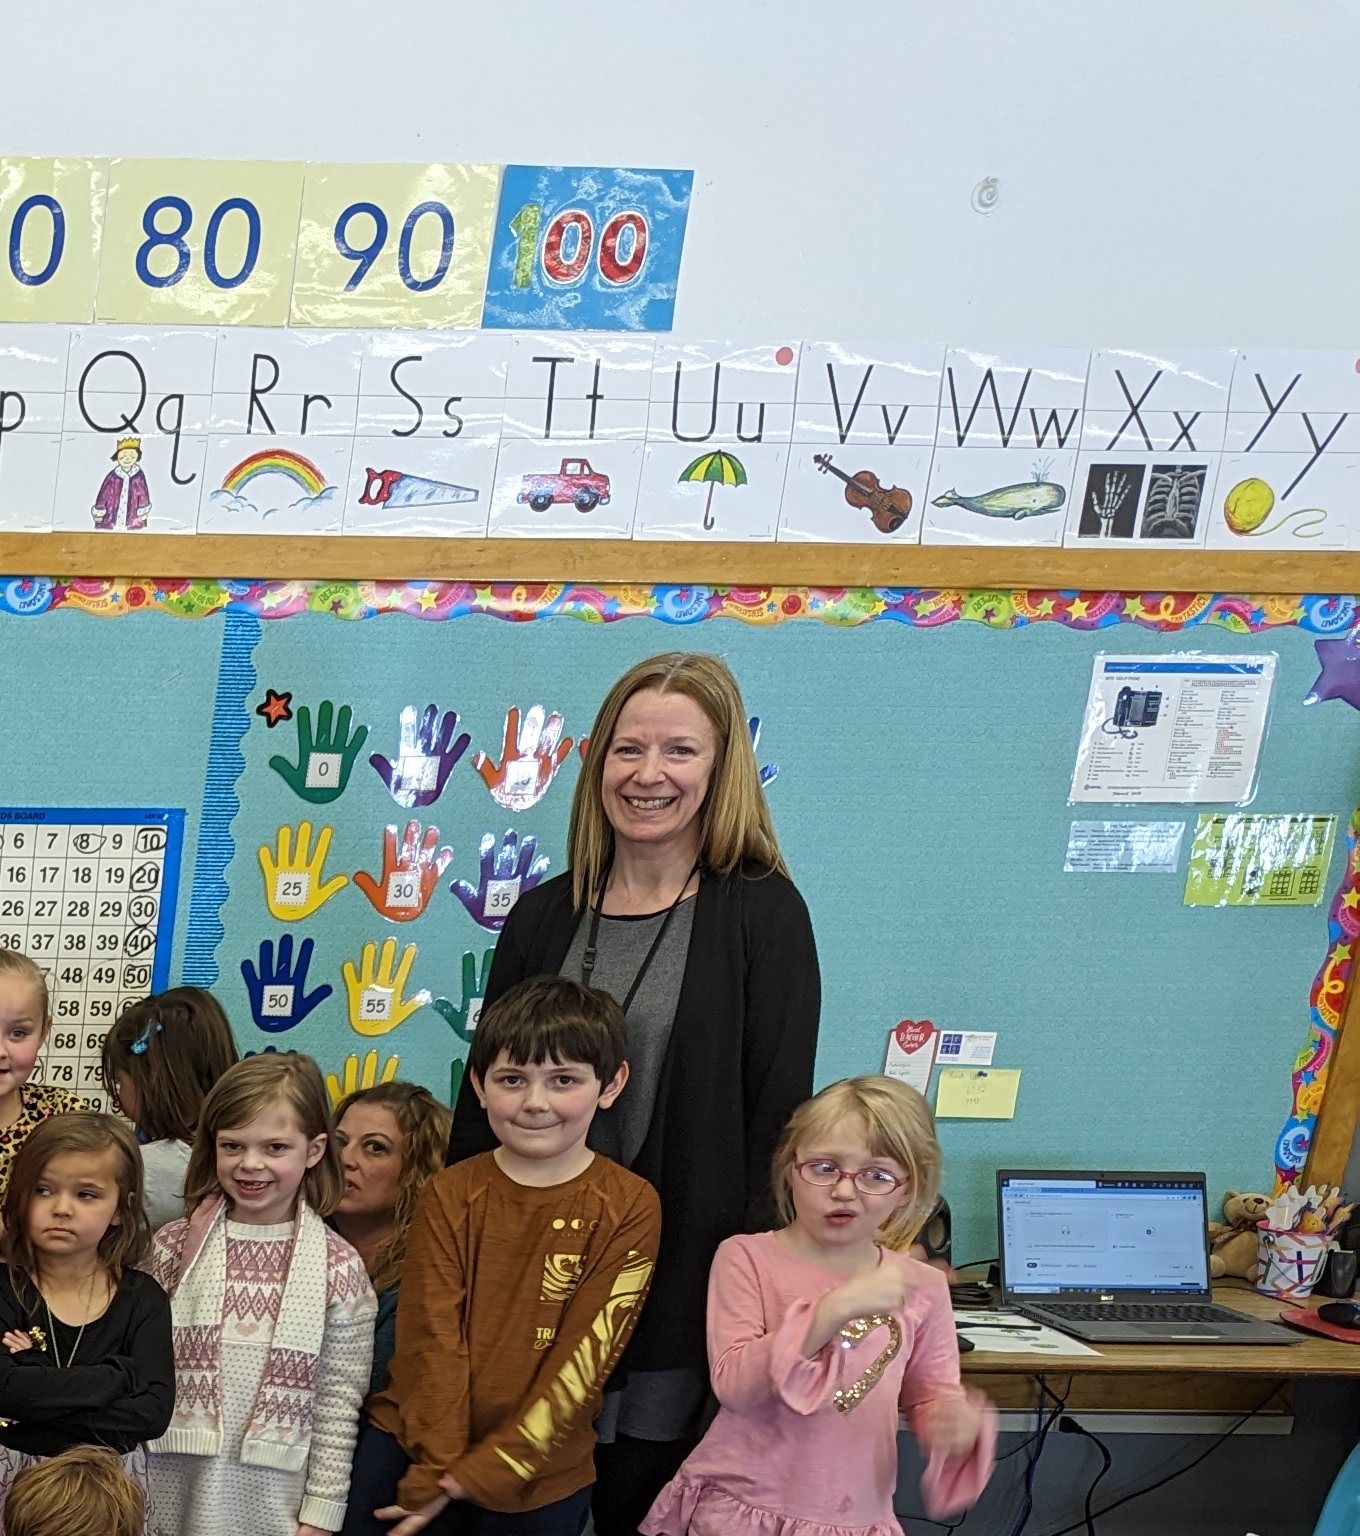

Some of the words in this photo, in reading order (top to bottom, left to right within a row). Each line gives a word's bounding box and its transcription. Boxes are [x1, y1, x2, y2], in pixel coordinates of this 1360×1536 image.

[135, 197, 262, 289] 80
[333, 201, 456, 293] 90
[509, 203, 650, 288] 100
[80, 351, 195, 484] Qq
[250, 355, 331, 436] Rr
[389, 356, 462, 437] Ss
[532, 357, 604, 439] Tt
[675, 361, 765, 444] Uu
[827, 364, 908, 445] Vv
[947, 367, 1079, 448] Ww
[1107, 370, 1201, 452] Xx
[1245, 373, 1348, 500] Yy
[282, 880, 301, 897] 25
[394, 883, 413, 900] 30
[491, 891, 511, 908] 35
[268, 993, 288, 1009] 50
[366, 997, 386, 1014] 55
